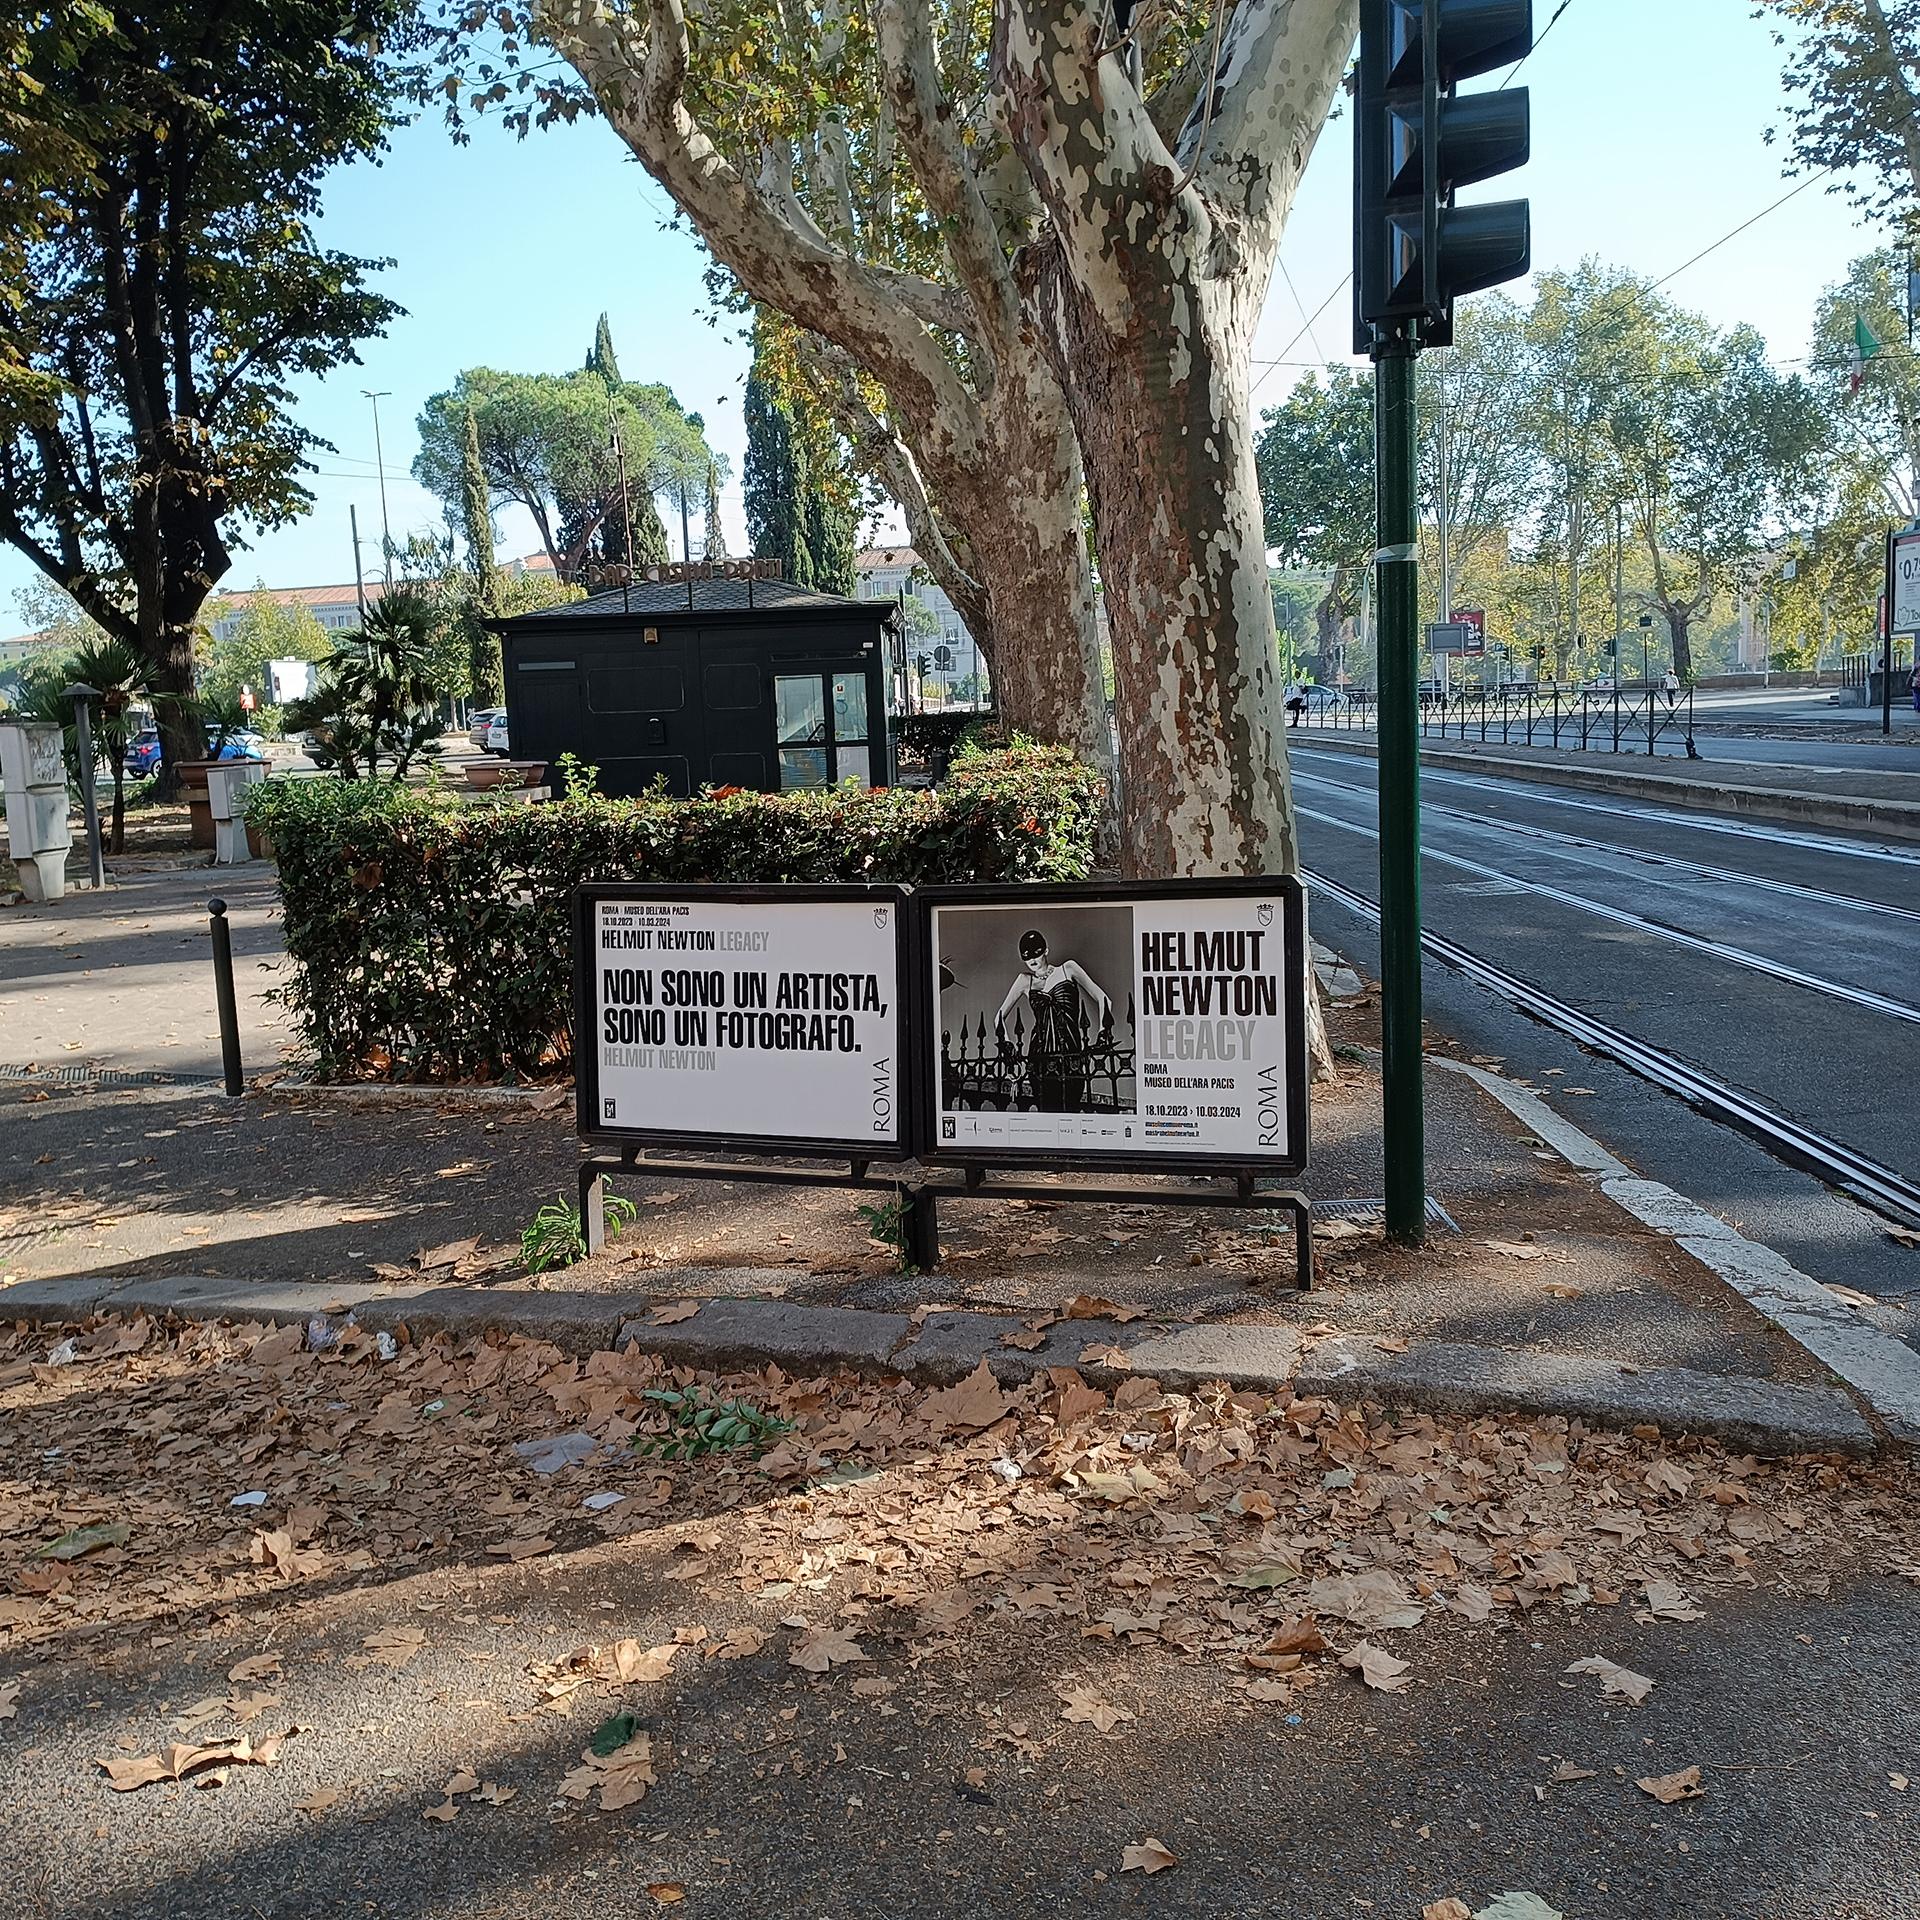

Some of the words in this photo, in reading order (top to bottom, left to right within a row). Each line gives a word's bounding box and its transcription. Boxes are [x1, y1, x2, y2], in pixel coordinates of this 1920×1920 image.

[601, 906, 619, 915] ROMA
[624, 906, 644, 916] MUSEO
[672, 907, 690, 916] PACIS
[602, 917, 633, 926] 18.10.2023
[638, 918, 671, 927] 10.03.2024
[602, 929, 653, 950] HELMUT
[657, 931, 715, 951] NEWTON
[720, 931, 769, 952] LEGACY
[1141, 930, 1265, 972] HELMUT
[603, 968, 653, 1006] NON
[661, 970, 725, 1008] SONO
[734, 971, 767, 1009] UN
[775, 973, 889, 1019] ARTISTA,
[1142, 975, 1277, 1016] NEWTON
[603, 1007, 666, 1046] SONO
[674, 1010, 708, 1048] UN
[715, 1011, 862, 1053] FOTOGRAFO.
[1143, 1019, 1257, 1061] LEGACY
[604, 1047, 654, 1069] HELMUT
[659, 1049, 716, 1071] NEWTON
[1144, 1063, 1168, 1075] ROMA
[873, 1057, 891, 1132] ROMA
[1144, 1077, 1172, 1088] MUSEO
[1174, 1077, 1209, 1089] DELL'ARA
[1211, 1078, 1235, 1089] PACIS
[1145, 1105, 1188, 1116] 18.10.2023
[1196, 1106, 1241, 1118] 10.03.2024
[1257, 1065, 1279, 1146] ROMA
